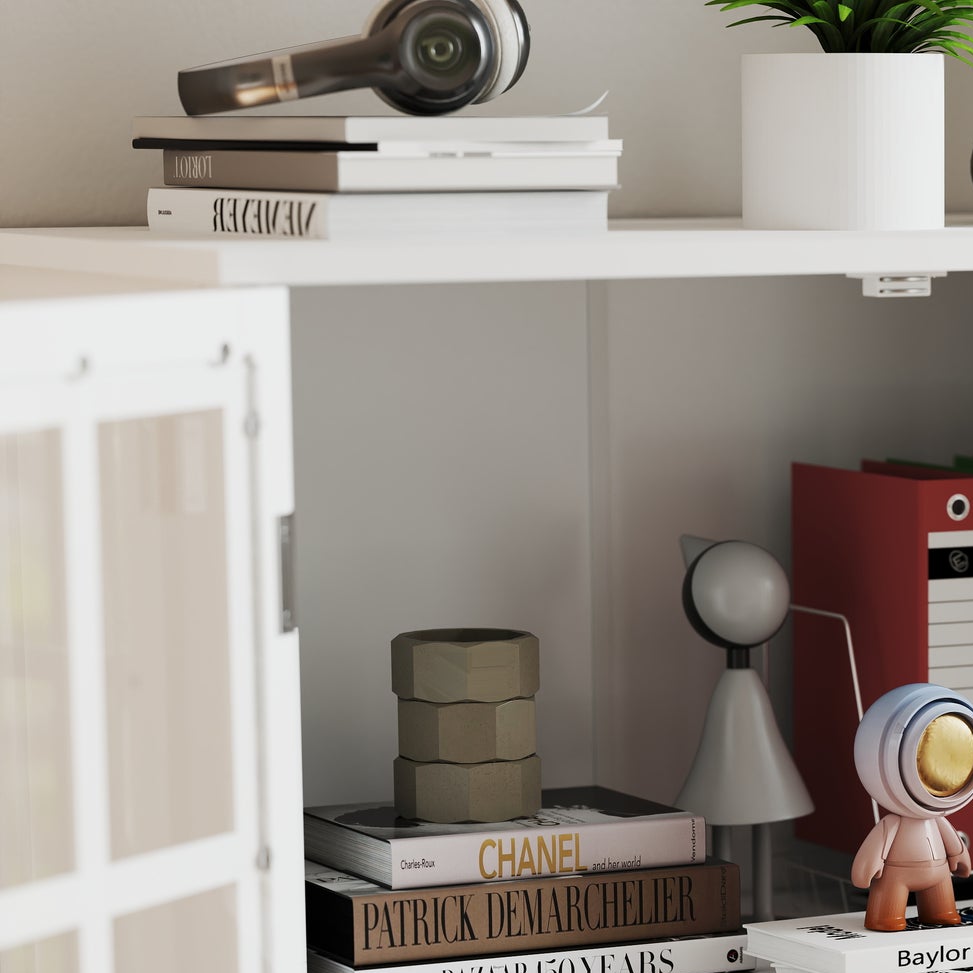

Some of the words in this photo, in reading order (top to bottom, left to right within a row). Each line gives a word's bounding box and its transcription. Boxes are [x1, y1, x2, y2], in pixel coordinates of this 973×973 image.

[400, 858, 436, 870] Charles-Roux
[478, 833, 588, 880] CHANEL
[592, 860, 606, 871] and
[607, 857, 620, 869] her
[621, 855, 642, 868] world
[361, 894, 479, 950] PATRICK
[486, 875, 697, 940] DEMARCHELIER
[898, 945, 972, 969] Baylor
